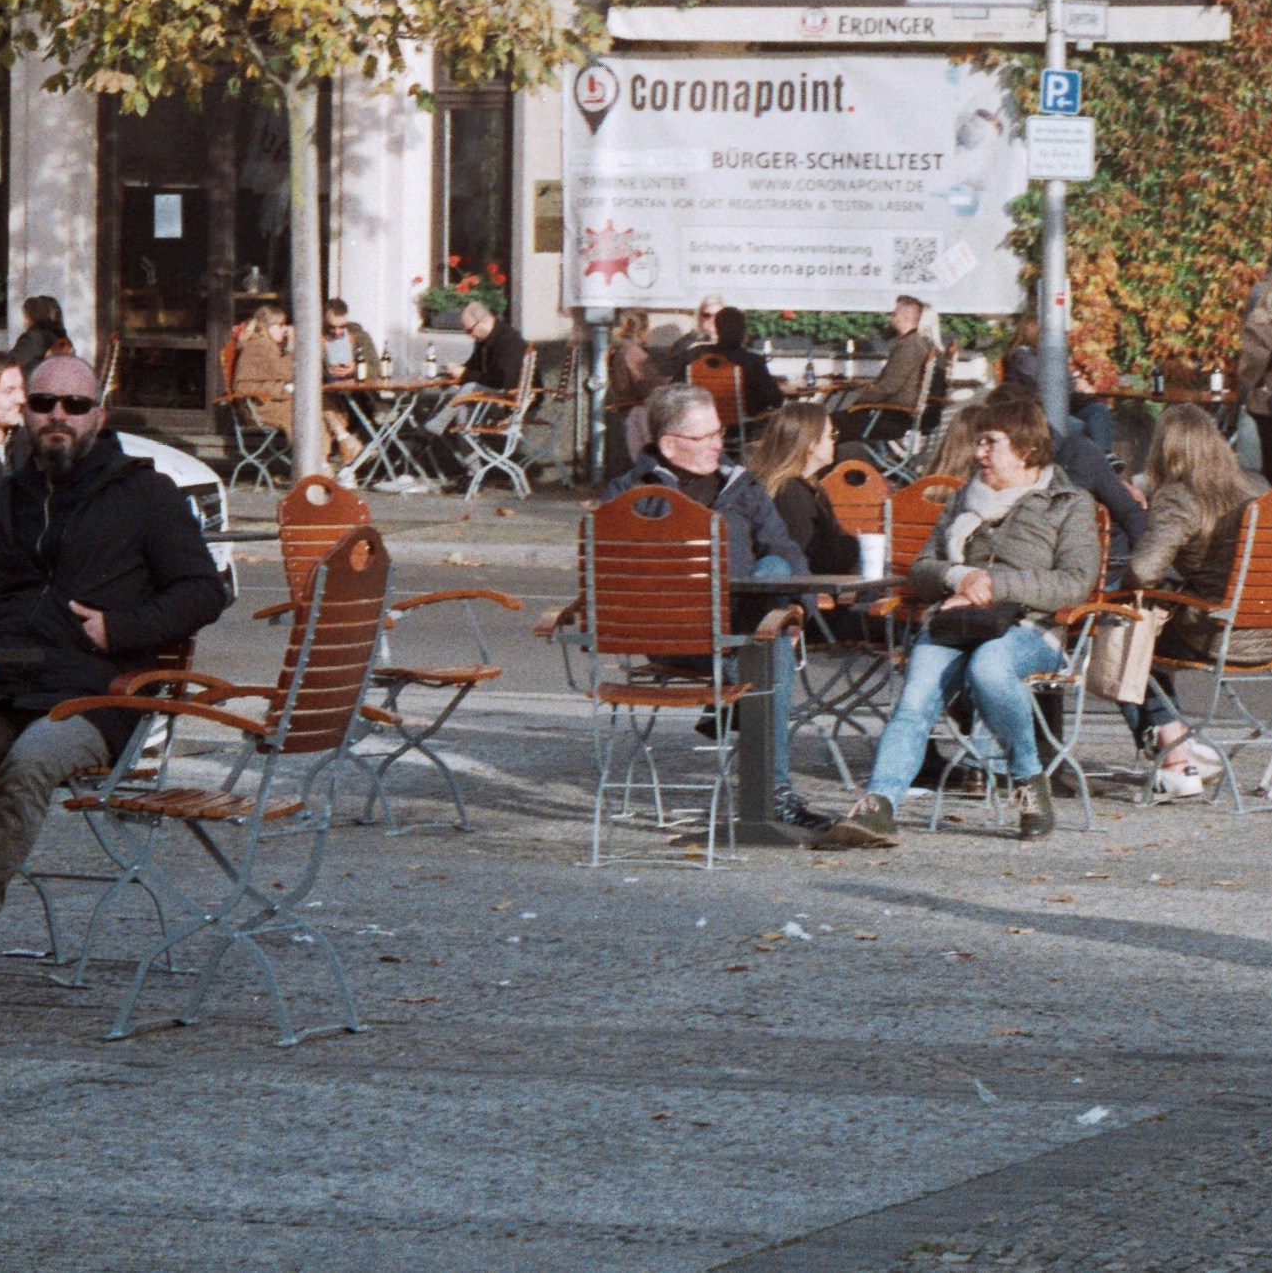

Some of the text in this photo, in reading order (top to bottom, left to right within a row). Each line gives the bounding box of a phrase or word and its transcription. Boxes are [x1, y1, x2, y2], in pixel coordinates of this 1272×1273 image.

[838, 14, 936, 37] ERDINGER
[630, 72, 856, 118] Coronapoint.
[1046, 74, 1069, 107] P
[712, 147, 944, 170] BÜRGER-SCHNELLTEST
[690, 262, 882, 278] www.coronapoint.de
